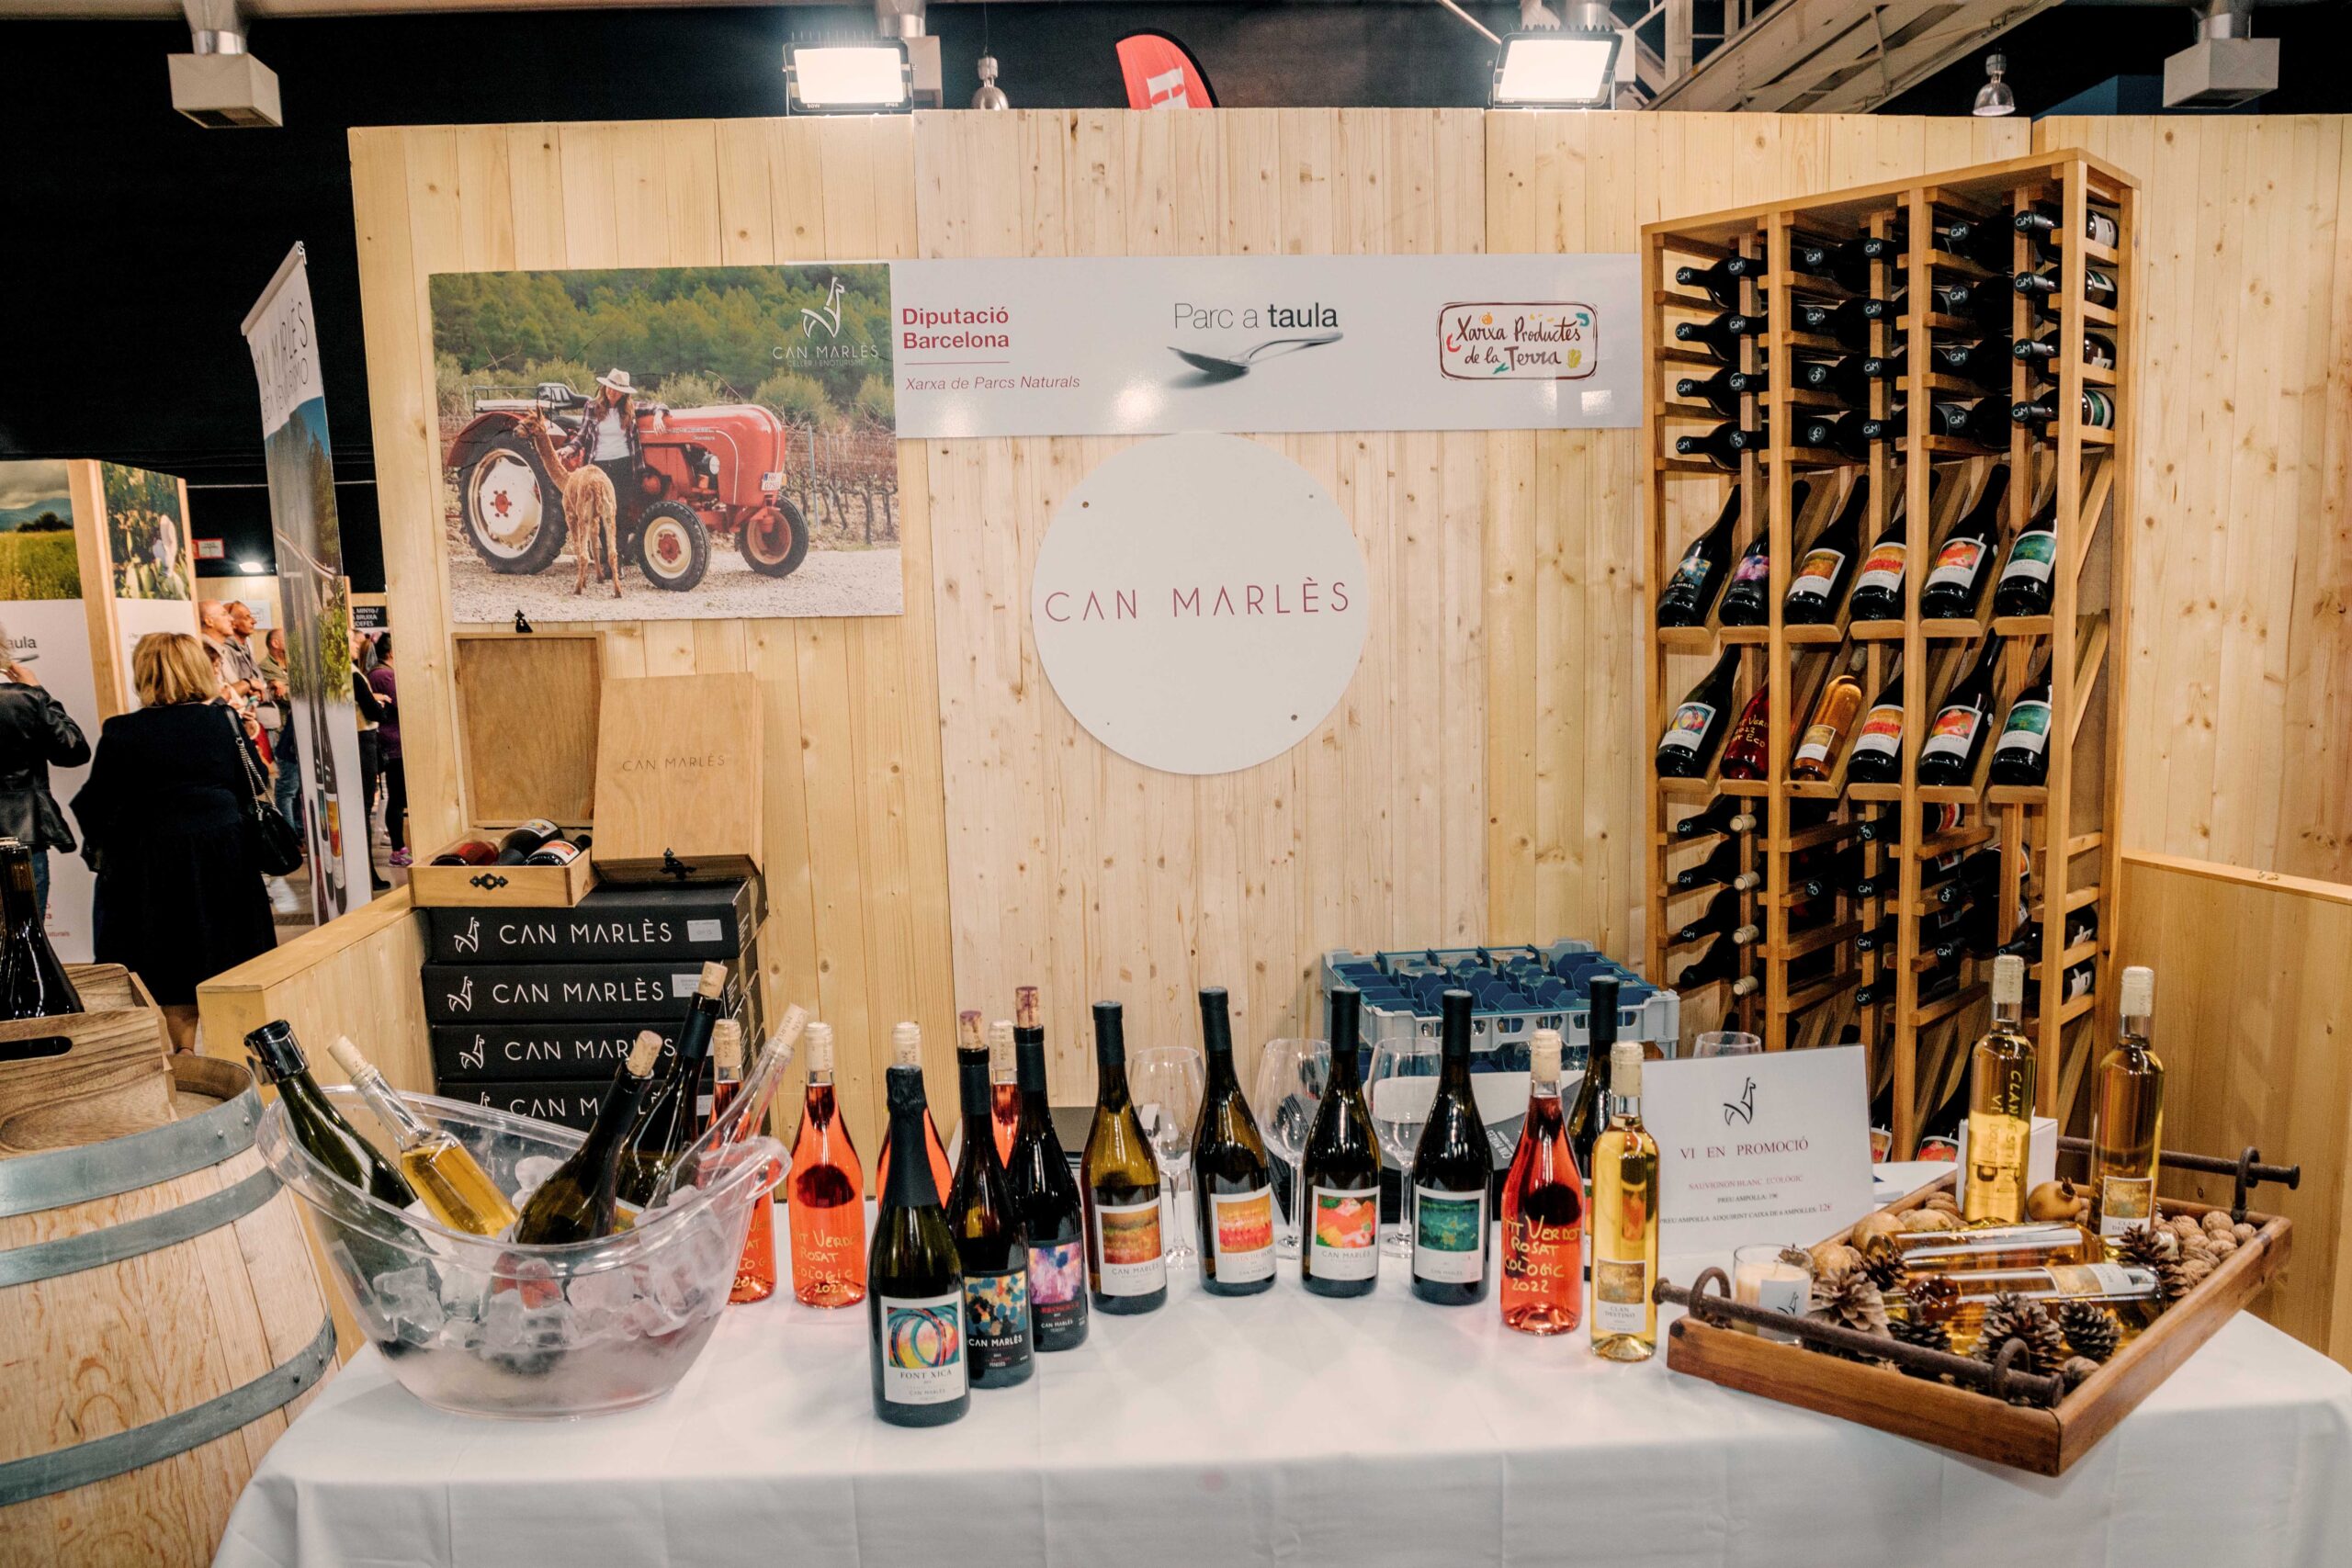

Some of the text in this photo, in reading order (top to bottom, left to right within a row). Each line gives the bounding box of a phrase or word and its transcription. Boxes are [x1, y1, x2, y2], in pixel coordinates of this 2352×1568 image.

[902, 307, 1009, 328] Diputació
[1174, 302, 1339, 330] Parc a taula
[903, 331, 1009, 349] Barcelona
[1455, 316, 1582, 344] Xarxa Productes
[773, 346, 808, 359] CAN
[1464, 345, 1562, 371] de la Terra
[905, 375, 1080, 390] Xarxa de Parcs Naturals
[1045, 576, 1349, 622] CAN MARLÈS
[9, 636, 37, 649] aula
[622, 752, 726, 772] CAN MARLÈS
[499, 924, 556, 944] CAN
[571, 919, 673, 943] MARLÈS
[492, 983, 549, 1004] CAN
[564, 977, 664, 1002] MARLÈS
[504, 1038, 675, 1062] CAN MARS
[510, 1098, 566, 1118] CAN
[1680, 1135, 1809, 1159] VI EN PROMOCIÓ
[1689, 1181, 1736, 1190] SAUVIGNON
[1737, 1179, 1763, 1188] BLANC
[1712, 1213, 1748, 1222] ADQUIRINT
[1748, 1211, 1770, 1219] CAIXA
[800, 1248, 839, 1263] ROSAT
[1510, 1236, 1560, 1257] ROSAT
[1111, 1268, 1129, 1276] CAN
[1511, 1279, 1550, 1293] 2022
[968, 1334, 1023, 1348] CAN MARLÈS
[931, 1369, 952, 1378] XICA
